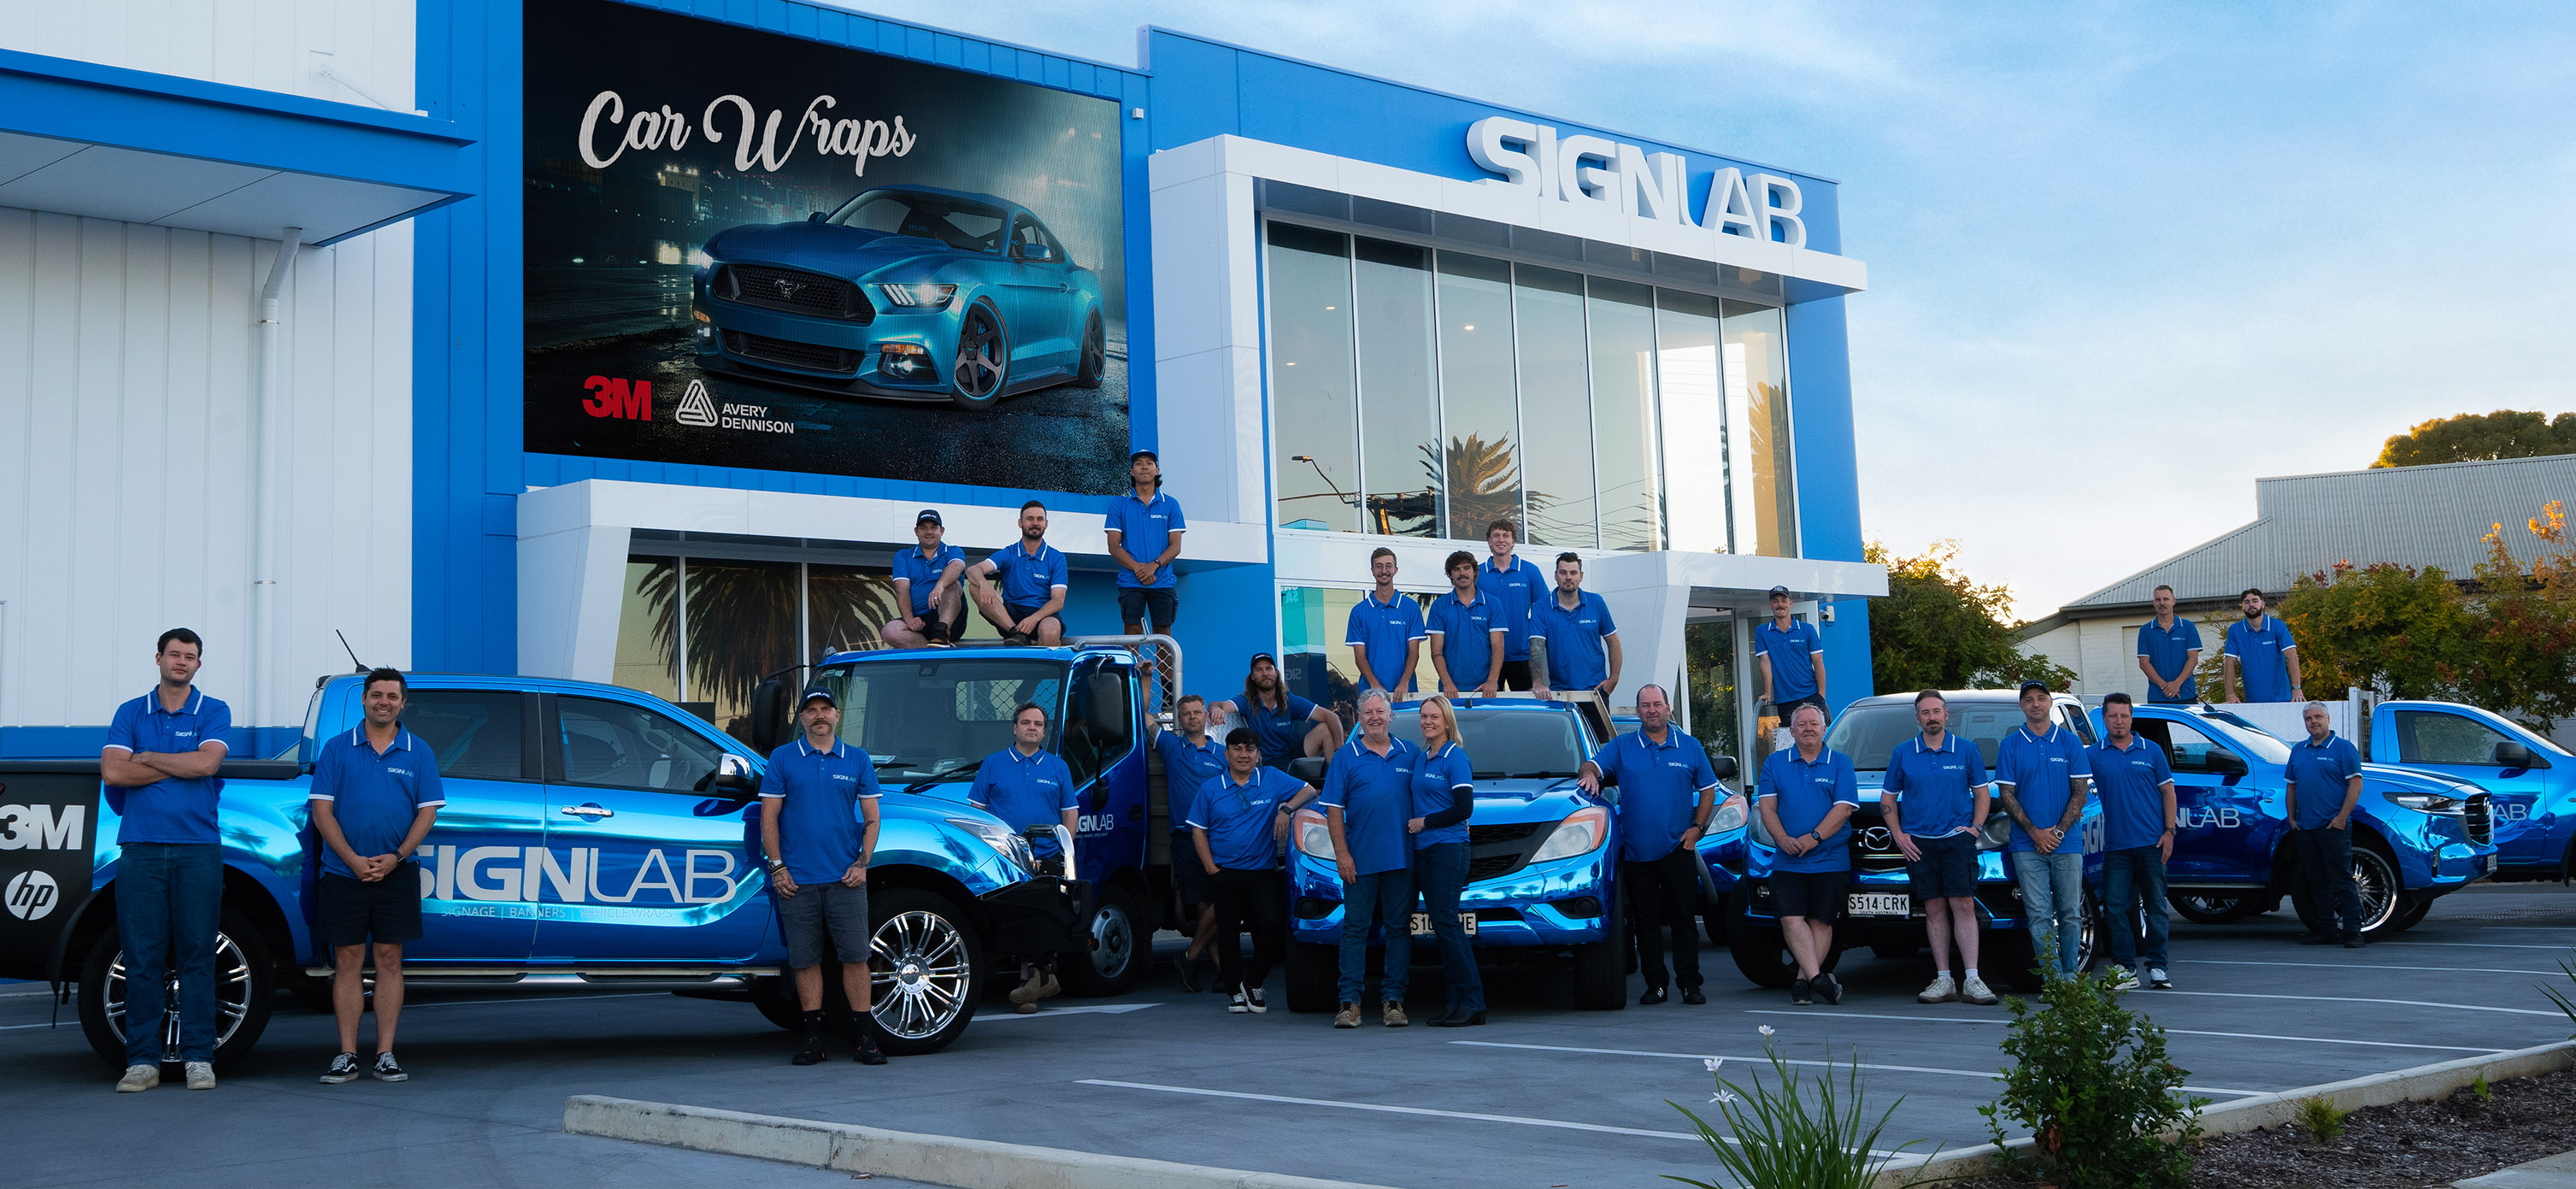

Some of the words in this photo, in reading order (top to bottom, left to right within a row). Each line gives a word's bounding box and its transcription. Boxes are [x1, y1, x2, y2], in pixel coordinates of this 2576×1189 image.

[579, 91, 691, 168] Car
[703, 95, 917, 177] Wraps
[1467, 116, 1808, 250] SIGNLAB
[582, 375, 652, 421] 3M
[722, 403, 768, 419] AVERY
[721, 417, 795, 434] DENNISON
[387, 768, 414, 777] SIGNLAB
[832, 774, 857, 783] SIGNLAB
[0, 804, 85, 851] 3M
[9, 870, 56, 921] hp
[442, 906, 496, 917] SIGNAGE
[509, 907, 566, 918] BANNERS
[579, 907, 628, 918] VEHICLE
[631, 908, 673, 919] WRAPS
